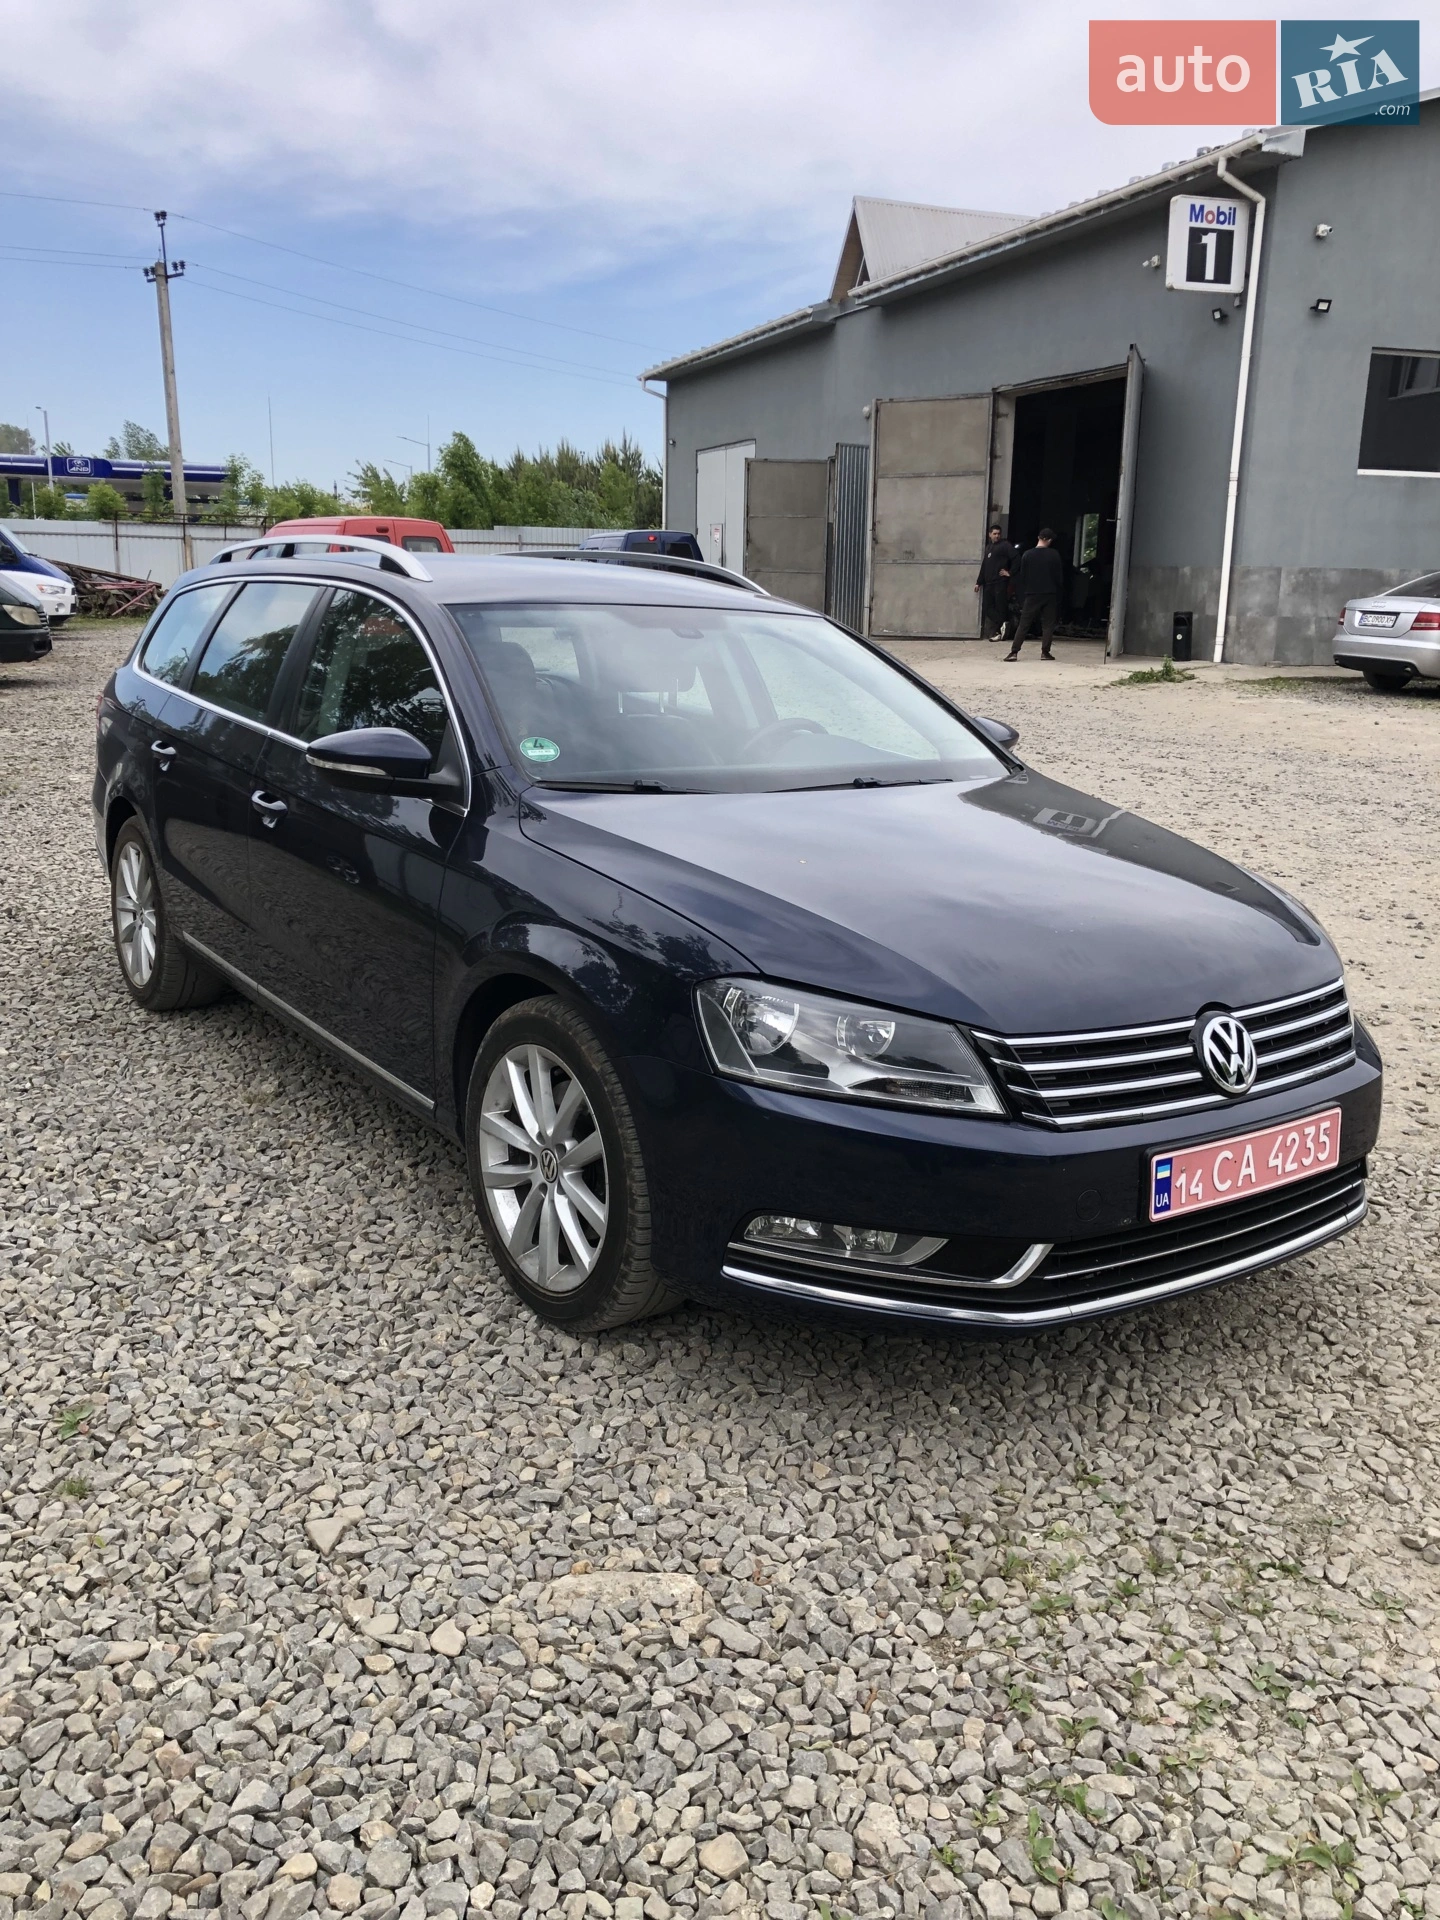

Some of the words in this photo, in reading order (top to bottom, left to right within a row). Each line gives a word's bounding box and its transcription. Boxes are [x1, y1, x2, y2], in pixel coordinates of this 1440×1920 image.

[1189, 203, 1236, 226] Mobil
[1199, 232, 1217, 281] 1
[1203, 1016, 1258, 1094] VW
[1174, 1168, 1203, 1204] 14
[1212, 1144, 1257, 1192] CA
[1268, 1121, 1331, 1176] 4235
[1156, 1193, 1169, 1207] UA
